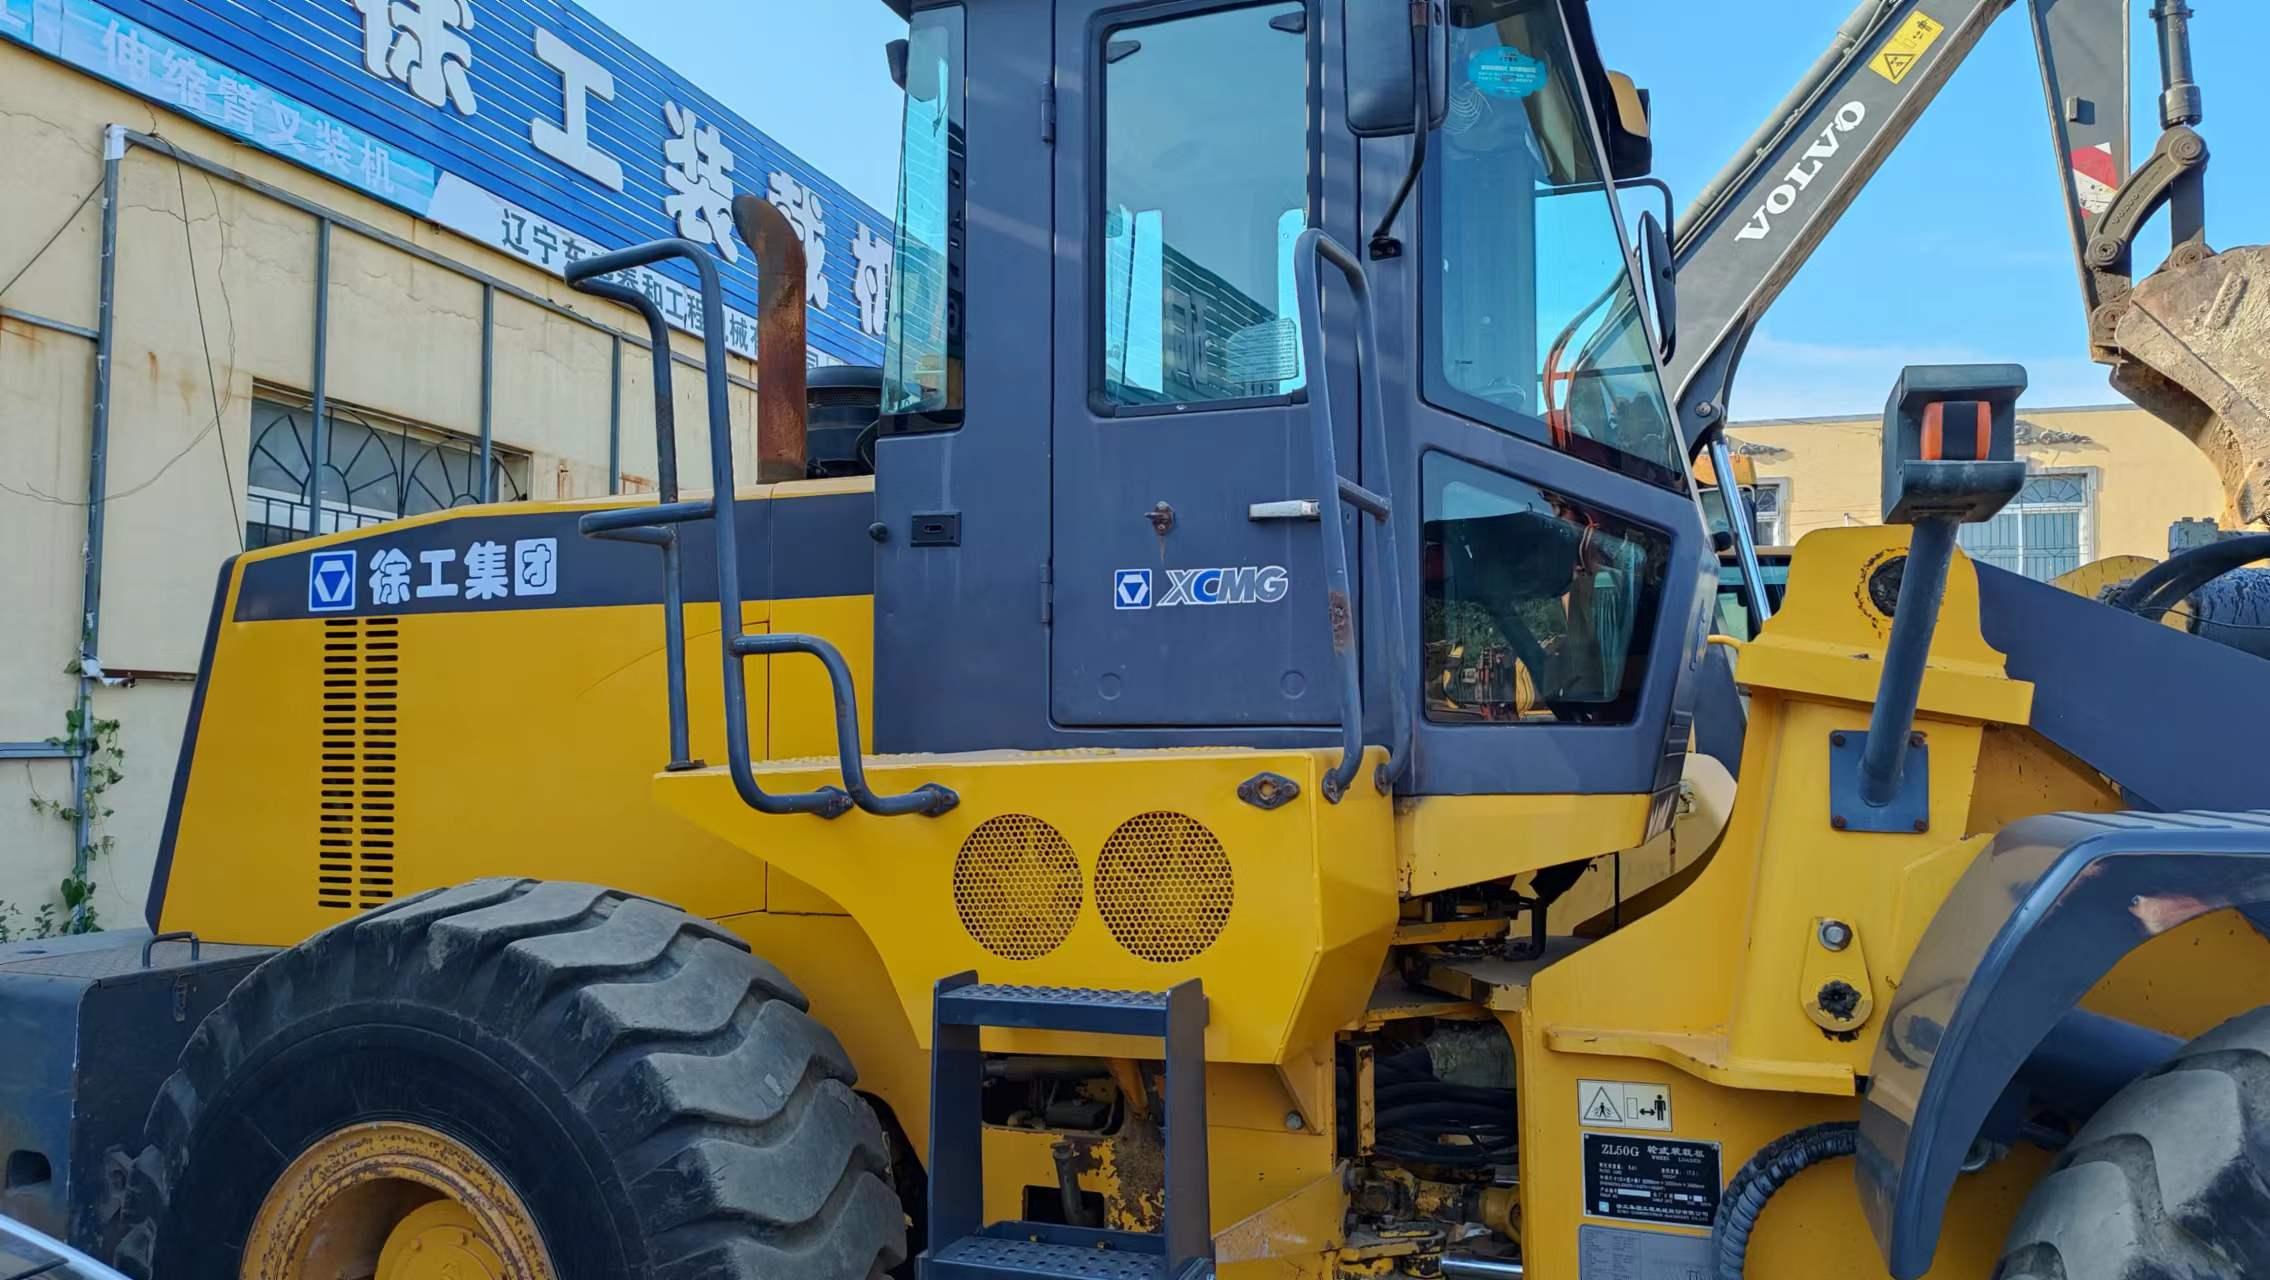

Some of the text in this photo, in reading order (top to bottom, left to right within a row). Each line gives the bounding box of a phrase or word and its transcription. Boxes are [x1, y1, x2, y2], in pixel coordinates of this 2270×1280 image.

[1734, 101, 1865, 241] VOLVO
[368, 537, 558, 606] 徐工集团
[1156, 565, 1289, 606] XCMG
[1600, 1143, 1640, 1157] ZL50G
